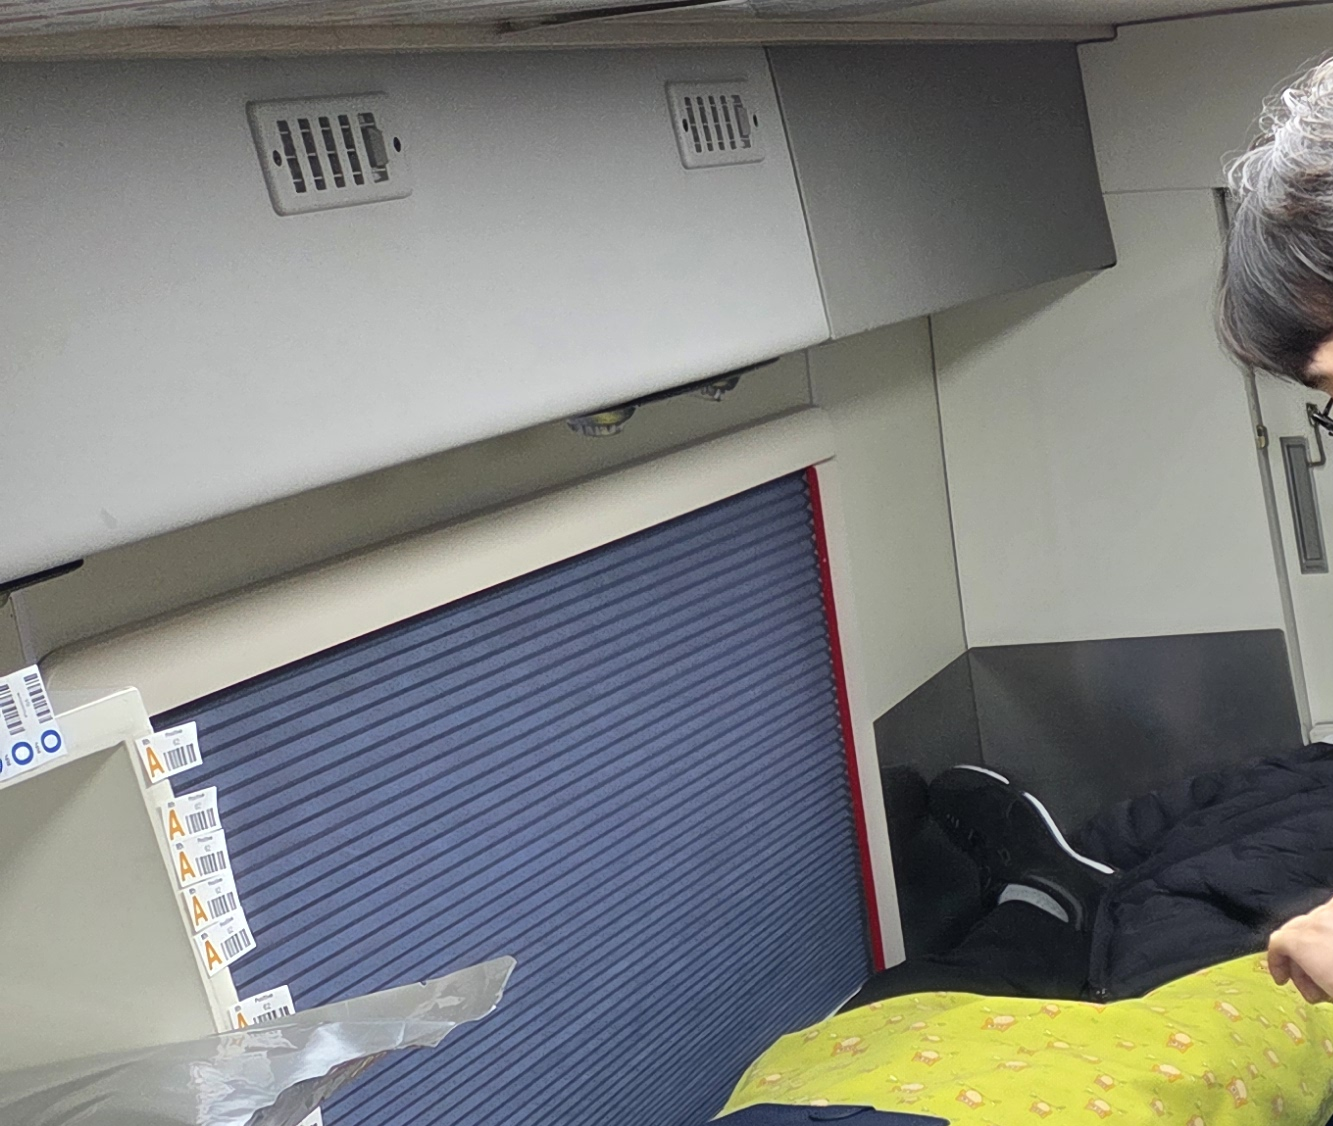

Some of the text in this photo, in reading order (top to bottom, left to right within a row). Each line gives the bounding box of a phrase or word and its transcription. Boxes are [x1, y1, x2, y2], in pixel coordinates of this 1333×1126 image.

[146, 746, 165, 778] A
[168, 808, 186, 841] A
[179, 851, 196, 881] A
[192, 895, 208, 926] A
[205, 940, 222, 971] A
